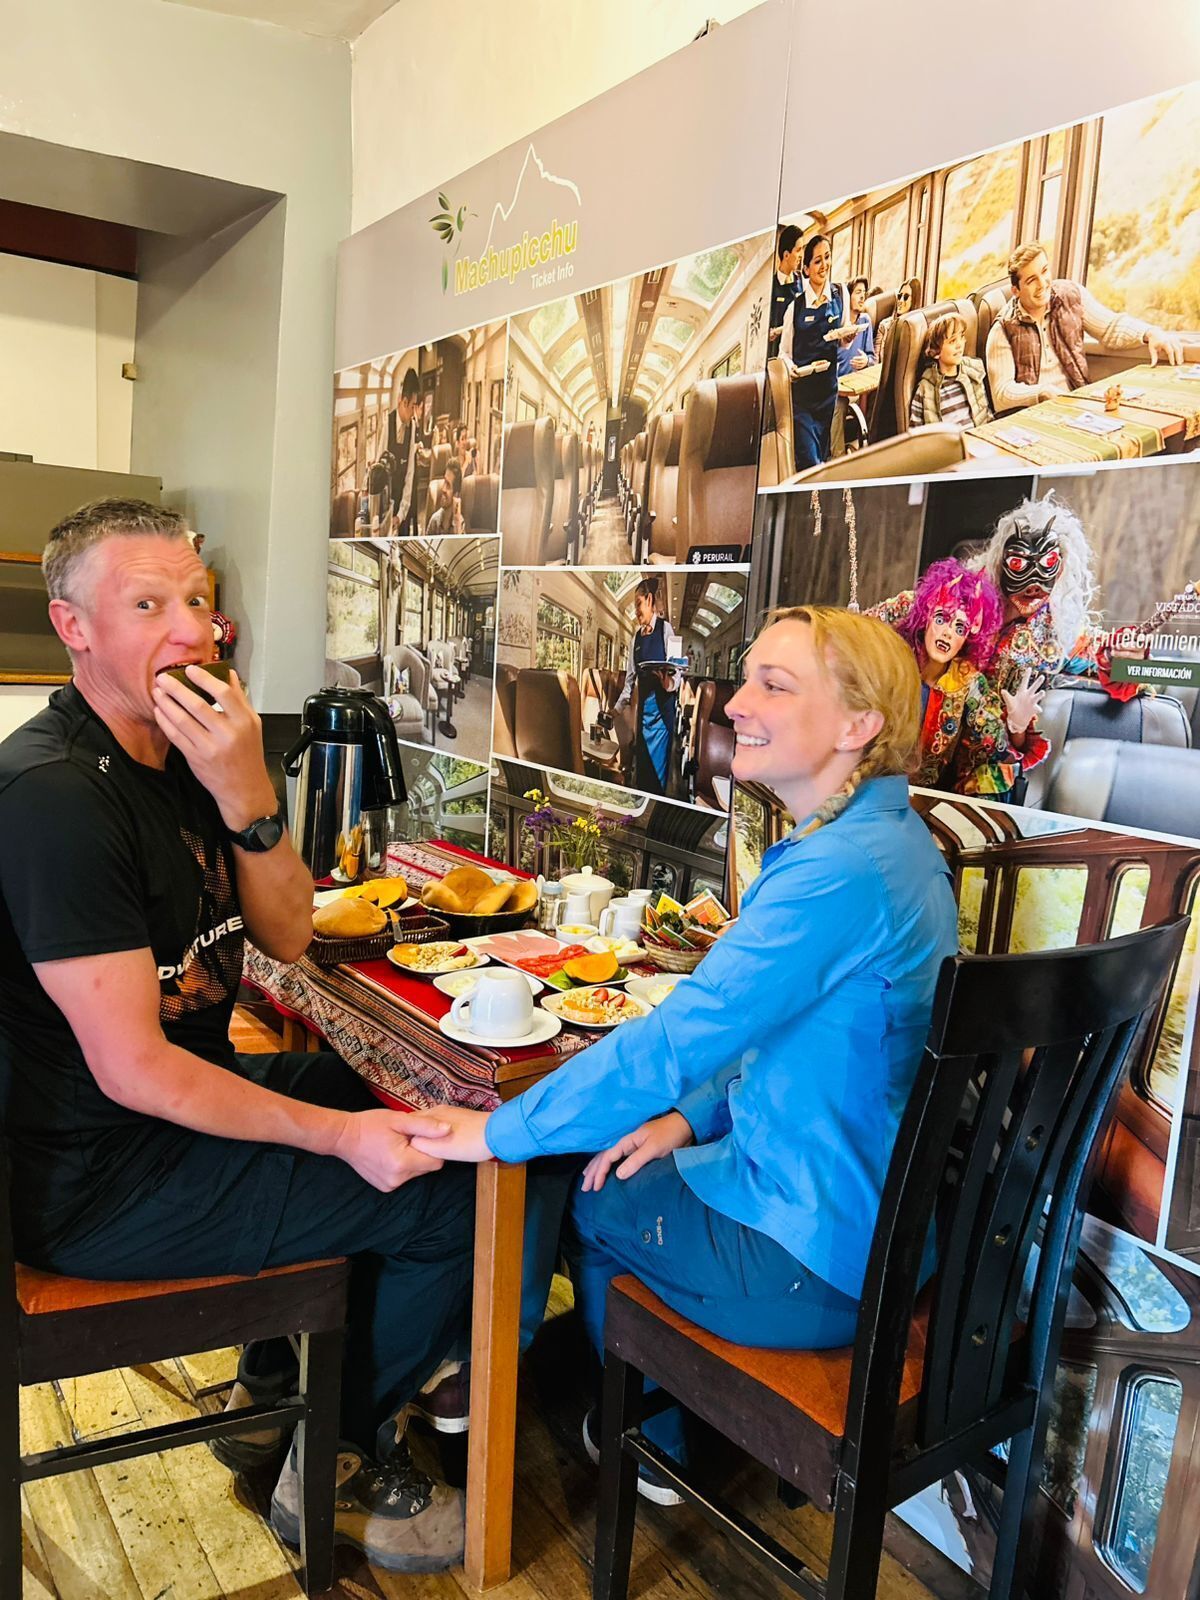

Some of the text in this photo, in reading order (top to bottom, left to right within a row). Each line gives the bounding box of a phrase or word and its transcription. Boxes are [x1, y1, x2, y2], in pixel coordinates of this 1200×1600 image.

[454, 219, 578, 296] Machupicchu
[531, 263, 574, 289] Ticket Info
[703, 553, 734, 562] PERURAIL
[1127, 665, 1192, 680] VER INFORMACIÓN
